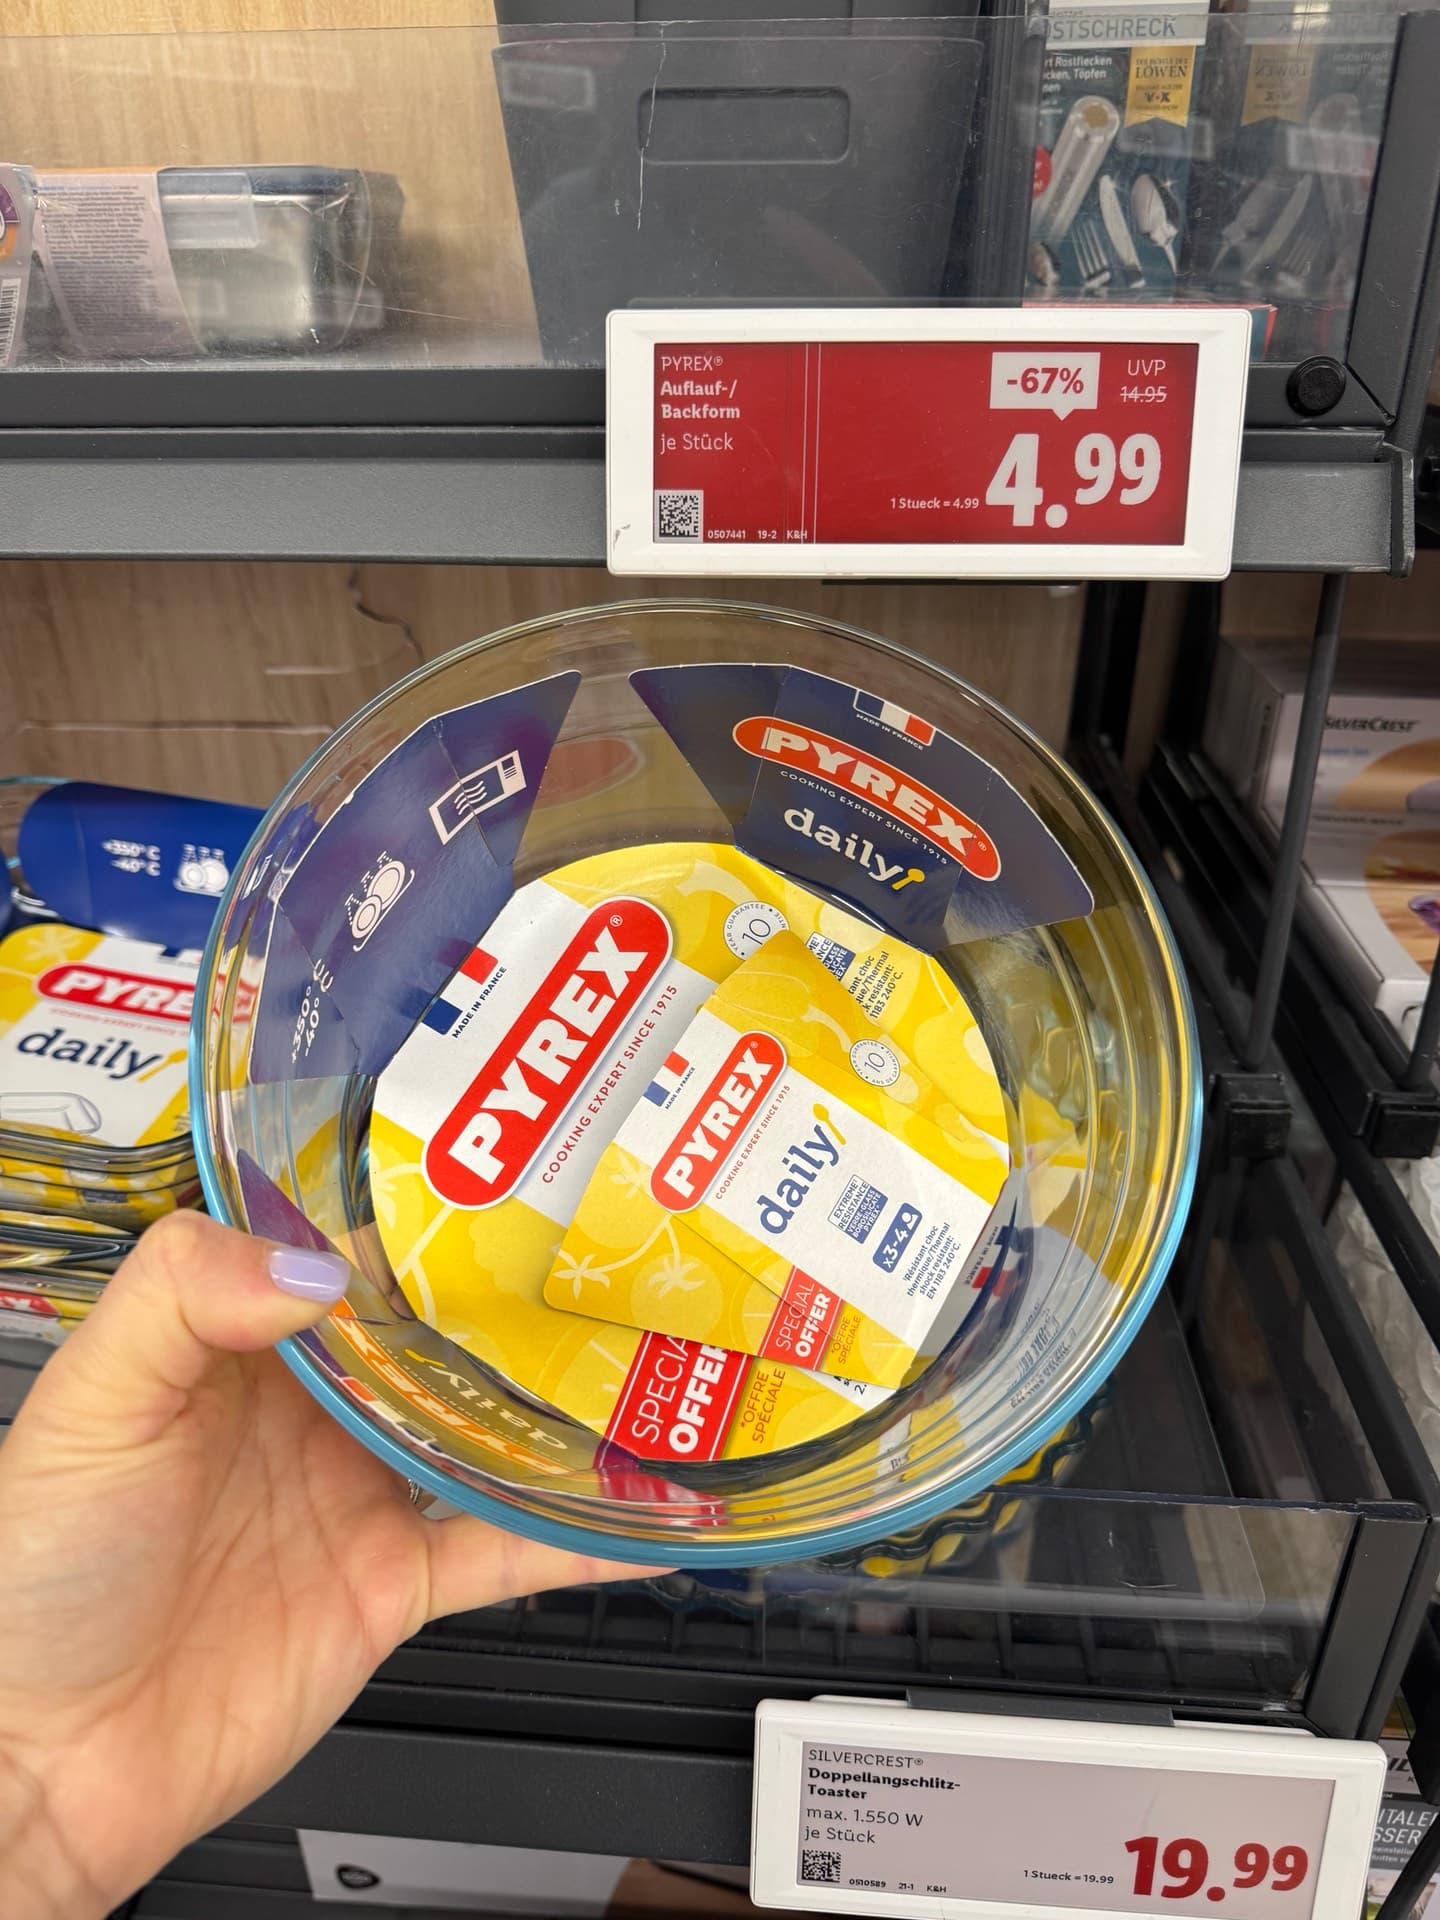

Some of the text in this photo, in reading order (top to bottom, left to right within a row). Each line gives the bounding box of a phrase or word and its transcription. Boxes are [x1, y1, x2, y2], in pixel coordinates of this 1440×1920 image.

[661, 354, 1166, 395] PYREX® -67% UVP
[661, 379, 738, 399] Auflauf-/
[1120, 385, 1168, 403] 14.95
[661, 403, 741, 420] Backform
[660, 431, 734, 455] je Stück
[986, 432, 1162, 528] 4.99
[953, 497, 980, 509] 4.99
[707, 530, 747, 539] 0507441
[757, 530, 777, 539] 19-2
[856, 713, 923, 750] MADE IN FRANCE
[780, 770, 948, 865] COOKING EXPERT SINCE 1915
[784, 807, 904, 881] daily
[742, 918, 771, 945] 10
[859, 955, 875, 977] choc
[52, 969, 196, 1016] PYRE
[452, 966, 507, 1038] MADE IN FRANCE
[869, 1000, 885, 1019] 1183
[17, 1027, 163, 1079] daily
[864, 1052, 885, 1073] 10
[542, 984, 679, 1184] COOKING EXPERT SINCE 1915
[716, 1160, 744, 1200] COOKING
[742, 1130, 763, 1160] EXPERT
[761, 1104, 778, 1129] SINCE
[756, 1124, 840, 1235] daily
[838, 1182, 868, 1229] RESISTANCE
[925, 1225, 938, 1245] choc
[919, 1235, 954, 1295] shock resistant:
[926, 1285, 938, 1300] EN
[934, 1268, 946, 1286] 1183
[775, 1283, 815, 1351] SPECIAL
[752, 1367, 786, 1444] SPÉCIALE
[808, 1749, 923, 1769] SILVERCREST®
[807, 1783, 868, 1802] Toaster
[808, 1766, 961, 1794] Doppellangschlitz-
[806, 1809, 924, 1827] max. 1.550 W
[804, 1826, 876, 1845] je Stück
[1083, 1873, 1115, 1885] 19.99
[1124, 1836, 1310, 1903] 19.99
[898, 1881, 915, 1891] 21-1
[926, 1884, 948, 1895] K&H
